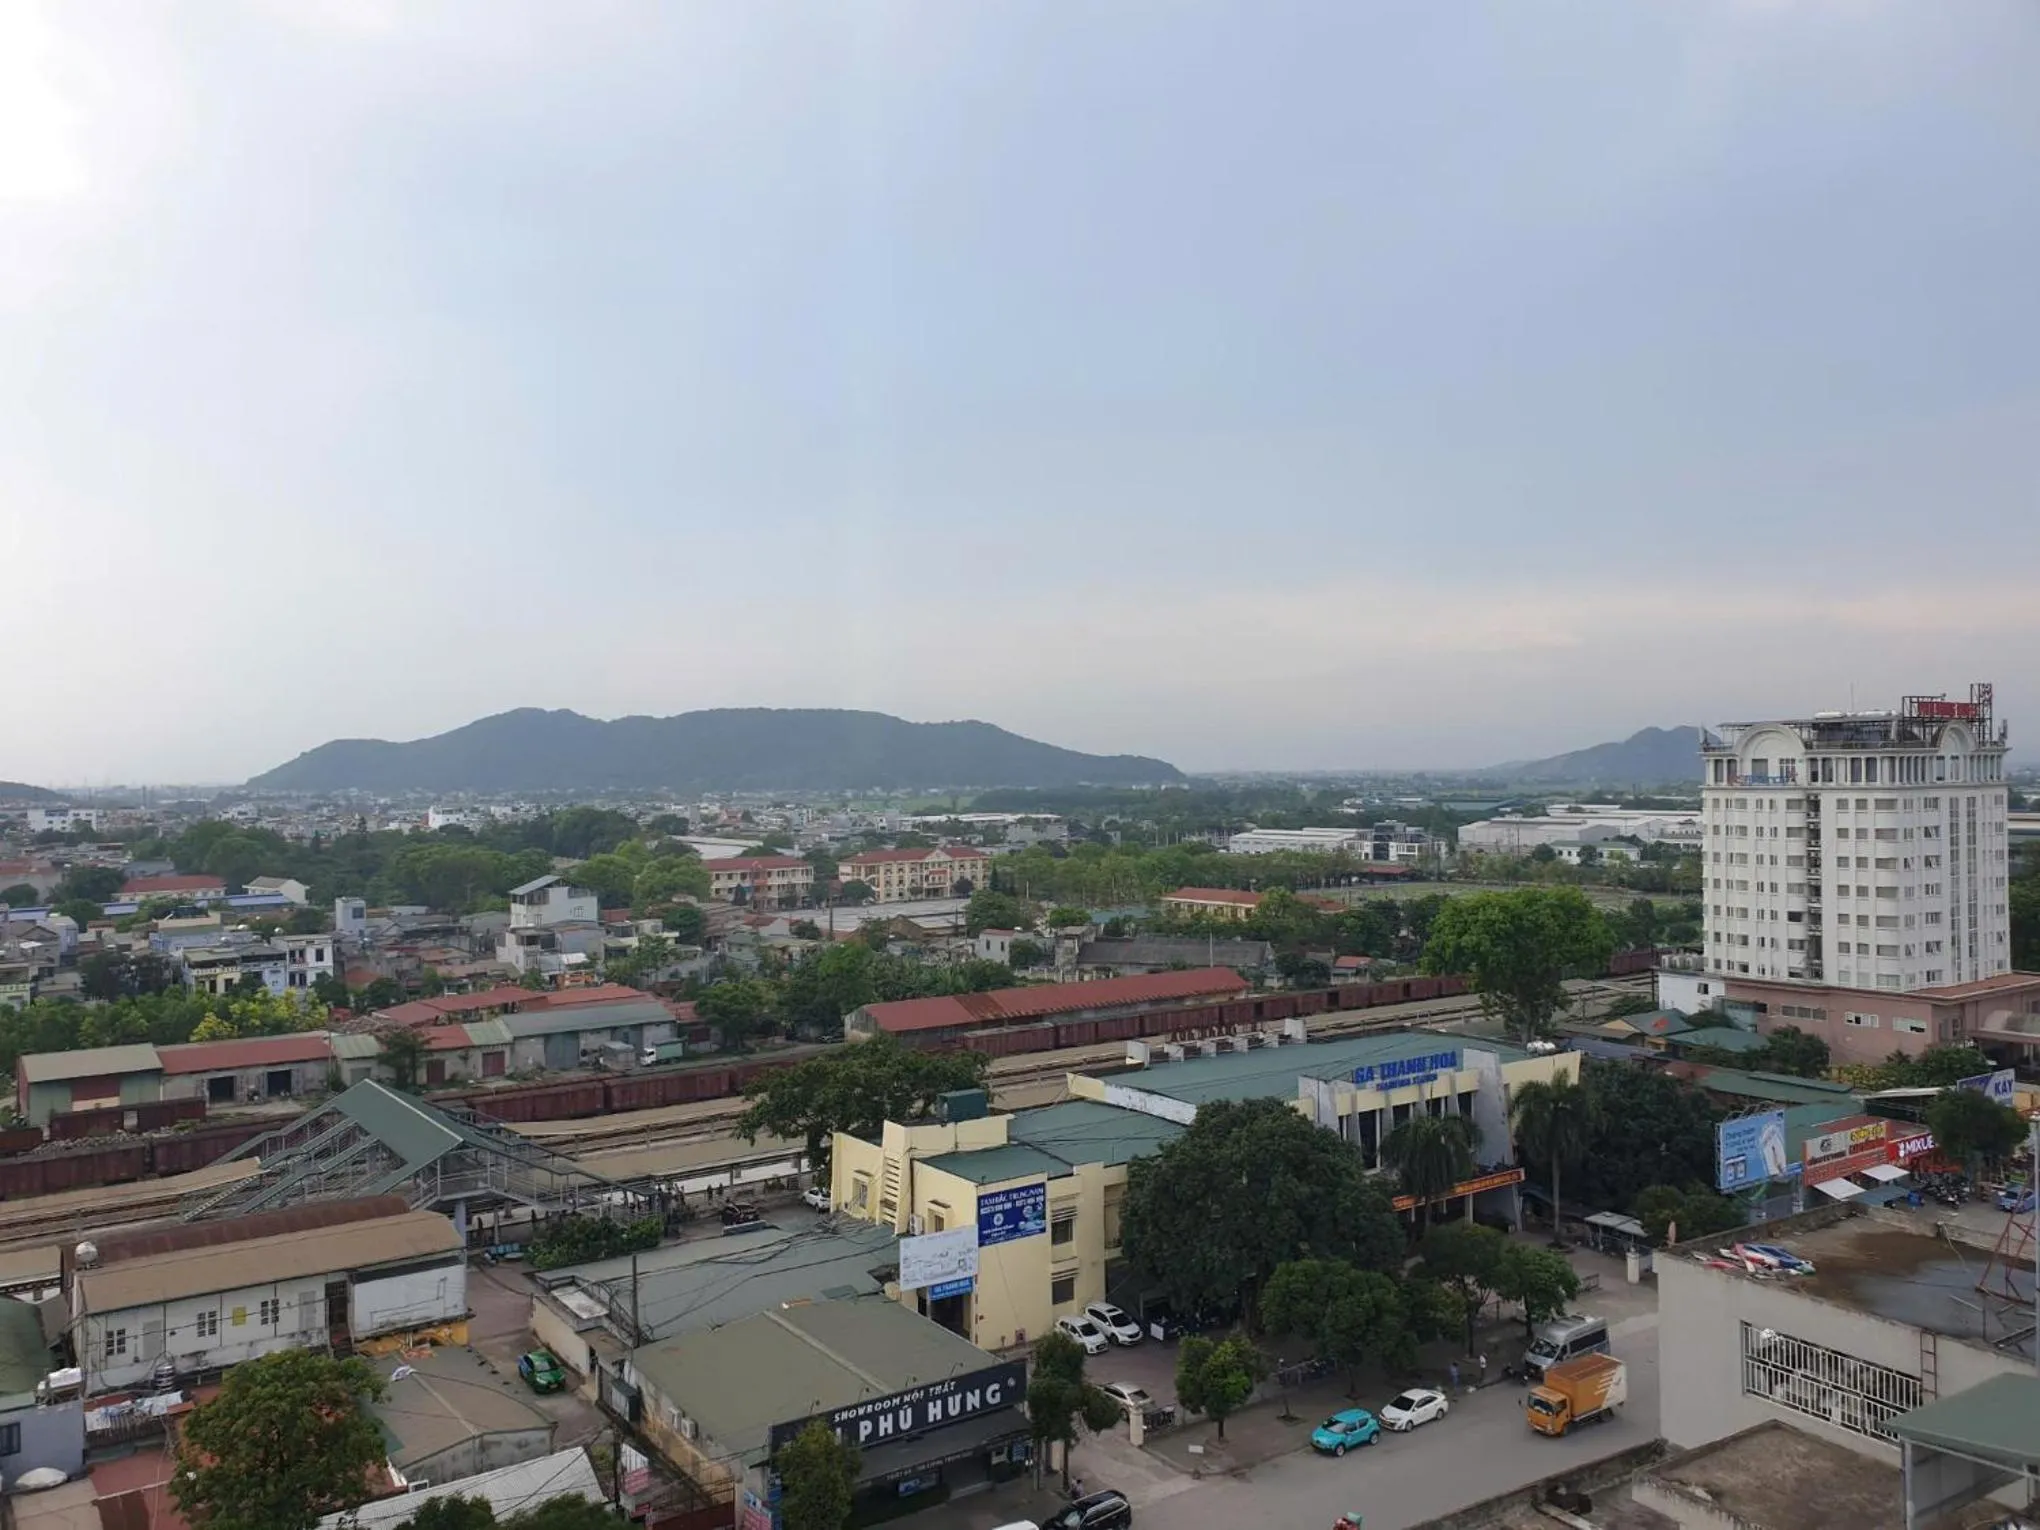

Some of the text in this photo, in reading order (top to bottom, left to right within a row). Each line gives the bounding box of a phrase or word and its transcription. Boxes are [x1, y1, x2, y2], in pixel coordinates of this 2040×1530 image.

[1355, 1066, 1374, 1084] GA
[1905, 1135, 1935, 1154] MIXUE
[833, 1397, 900, 1424] SHOWROOM
[902, 1390, 925, 1405] NỘI
[859, 1406, 912, 1443] PHÚ
[928, 1382, 1001, 1424] HƯNG
